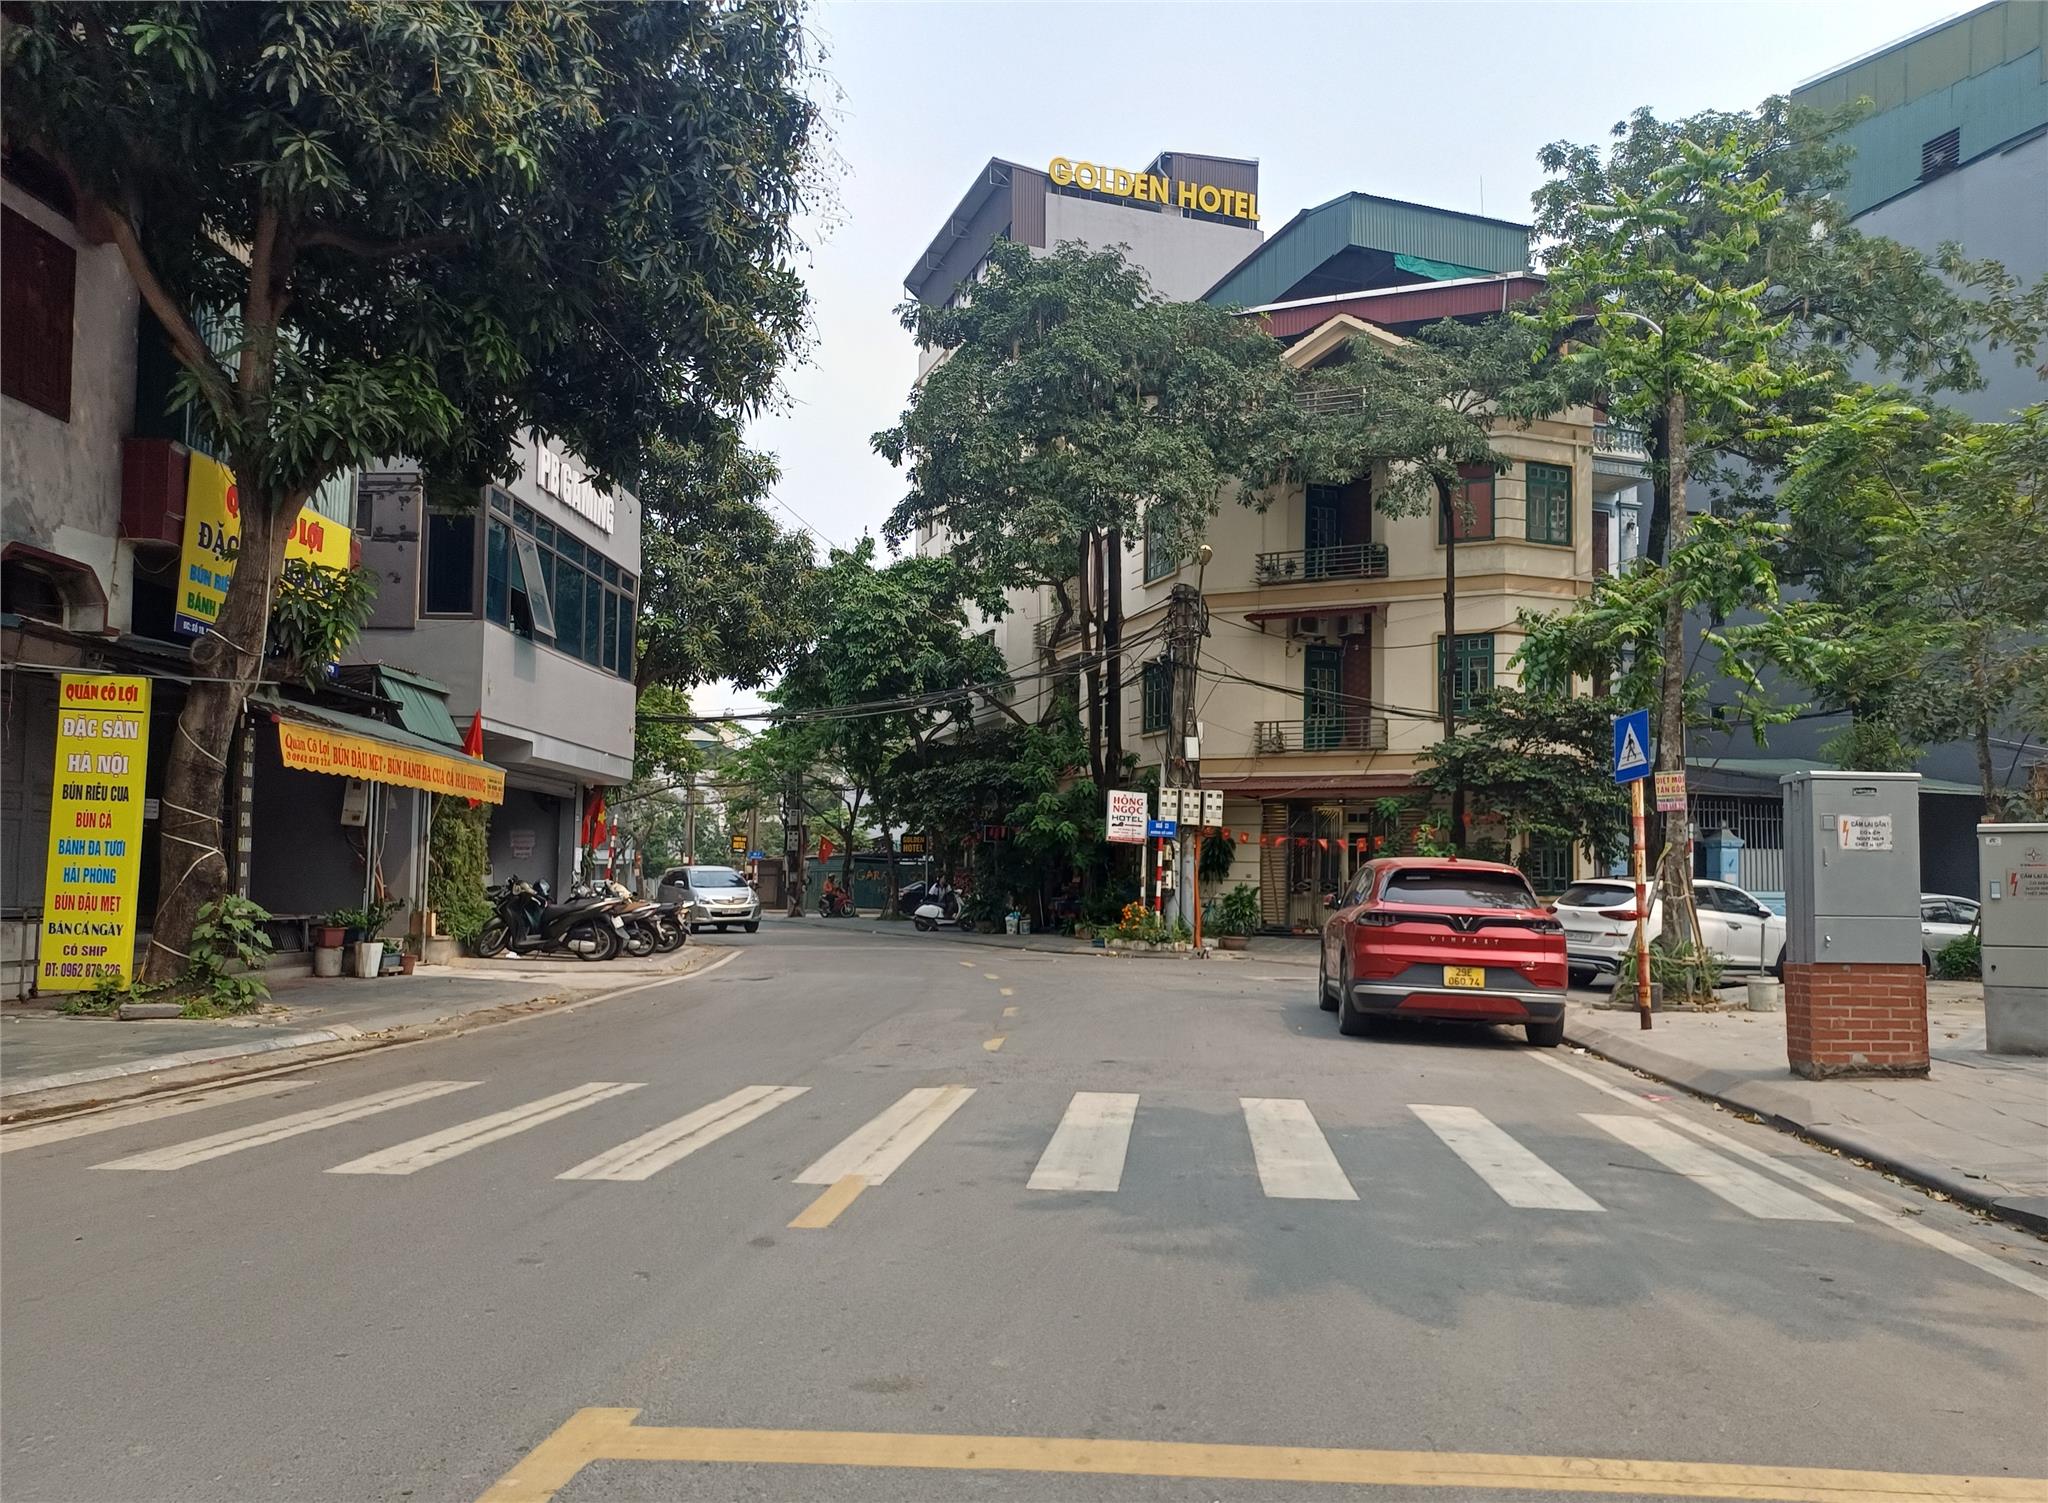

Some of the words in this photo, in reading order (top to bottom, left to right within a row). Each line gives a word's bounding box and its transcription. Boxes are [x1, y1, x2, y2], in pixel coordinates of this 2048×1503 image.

[1049, 157, 1170, 205] GOLDEN
[1178, 180, 1260, 222] HOTEL
[189, 564, 212, 587] BÚN
[187, 591, 216, 617] BÁNH
[65, 680, 99, 702] QUÁN
[100, 682, 116, 701] CÔ
[118, 684, 139, 705] LỢI
[62, 714, 98, 741] ĐẶC
[102, 714, 139, 740] SẢN
[307, 737, 318, 753] Cô
[67, 750, 93, 773] HÀ
[96, 752, 129, 778] NỘI
[333, 742, 350, 767] BÚN
[351, 746, 368, 774] ĐẬU
[387, 754, 403, 775] BÚN
[432, 767, 445, 785] CUA
[62, 780, 84, 800] BÚN
[85, 782, 108, 802] RIÊU
[110, 785, 129, 802] CUA
[76, 809, 97, 828] BÚN
[99, 809, 112, 829] CÁ
[1111, 814, 1144, 823] HOTEL
[1113, 805, 1143, 816] NGỌC
[58, 836, 86, 856] BÁNH
[88, 840, 101, 856] ĐA
[104, 840, 126, 857] TƯƠI
[903, 843, 925, 853] HOTEL
[63, 862, 80, 883] HẢI
[82, 864, 117, 884] PHÒNG
[54, 891, 76, 911] BÚN
[77, 892, 98, 915] ĐẬU
[100, 896, 122, 916] MẸT
[48, 919, 73, 935] BÁN
[91, 921, 124, 937] NGÀY
[63, 943, 78, 956] CÓ
[81, 945, 108, 957] SHIP
[1430, 935, 1499, 945] VINFAST
[45, 962, 59, 977] ĐT:
[60, 963, 83, 978] 0962
[104, 963, 121, 978] 226
